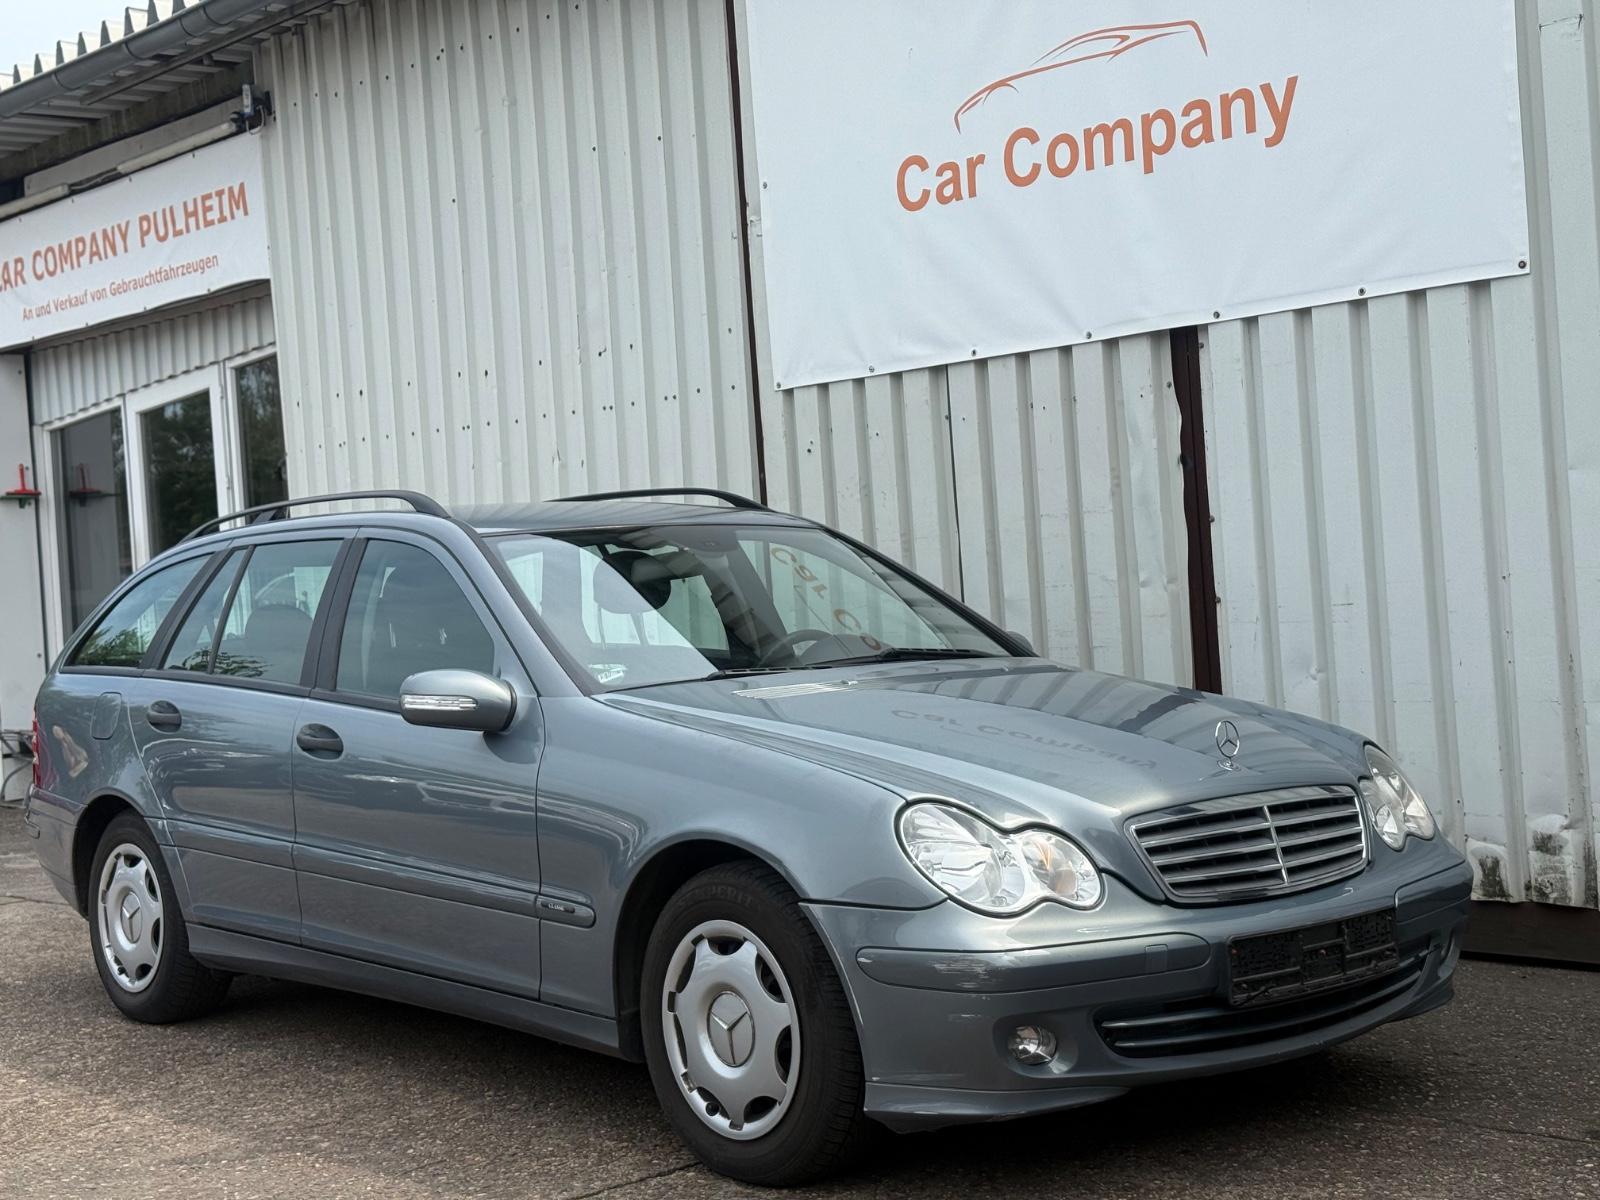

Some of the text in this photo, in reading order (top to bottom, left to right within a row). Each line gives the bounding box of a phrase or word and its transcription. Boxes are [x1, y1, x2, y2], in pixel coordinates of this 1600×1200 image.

[897, 76, 1298, 212] Car Company
[0, 182, 249, 292] AR COMPANY PULHEIM
[22, 254, 219, 321] An und Verkauf von Gebrauchtfahrzeugen
